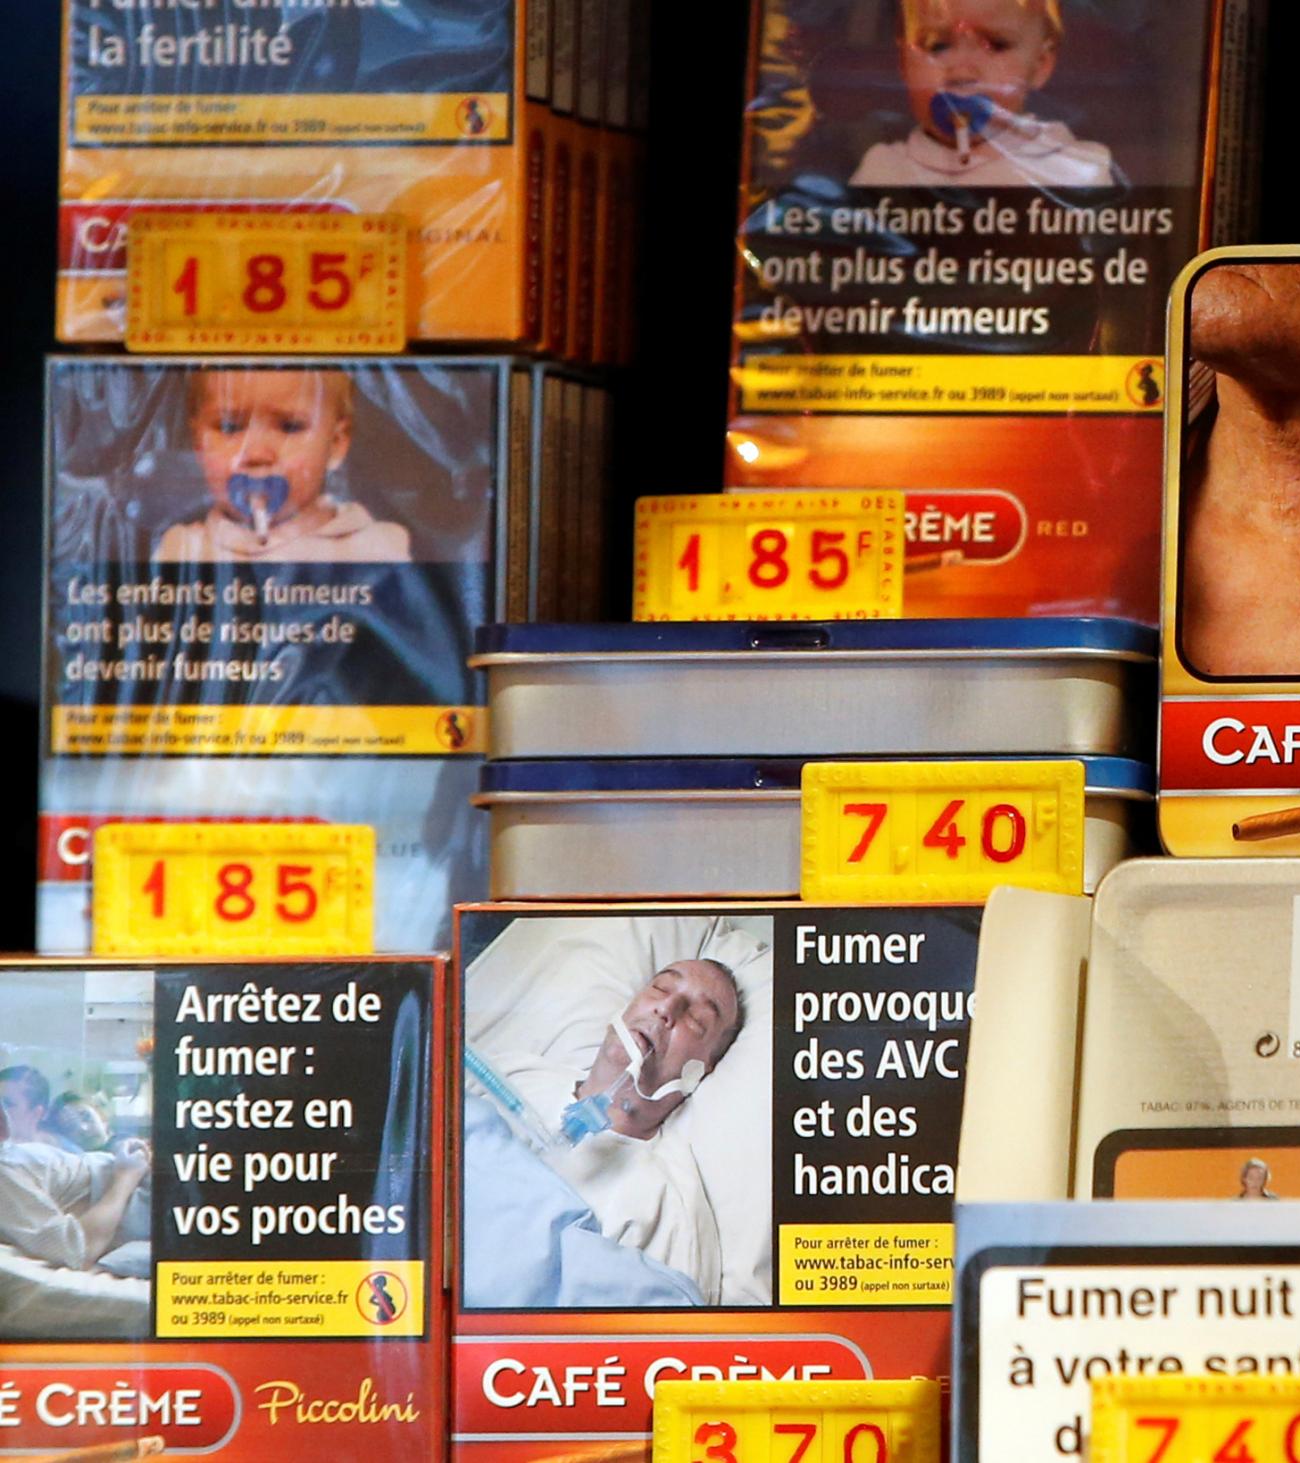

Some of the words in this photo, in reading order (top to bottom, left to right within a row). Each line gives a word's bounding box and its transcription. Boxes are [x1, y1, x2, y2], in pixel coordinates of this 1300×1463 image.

[89, 24, 124, 66] la
[139, 24, 292, 66] fertilité
[767, 200, 820, 235] Les
[832, 199, 963, 235] enfants
[974, 198, 1015, 235] de
[1027, 198, 1173, 235] fumeurs
[763, 256, 820, 284] ont
[831, 248, 903, 291] plus
[914, 248, 957, 284] de
[969, 249, 1094, 293] risques
[1104, 248, 1148, 284] de
[761, 299, 894, 335] devenir
[903, 298, 1050, 335] fumeurs
[905, 504, 995, 543] RÈME
[1037, 521, 1088, 537] RED
[68, 580, 108, 605] Les
[116, 578, 215, 605] enfants
[223, 577, 255, 605] de
[263, 577, 372, 605] fumeurs
[66, 621, 112, 642] ont
[118, 615, 173, 647] plus
[180, 615, 212, 642] de
[220, 615, 315, 647] risques
[320, 614, 355, 642] de
[66, 654, 165, 682] devenir
[173, 653, 285, 682] fumeurs
[796, 925, 925, 964] Fumer
[176, 984, 321, 1024] Arrêtez
[332, 982, 381, 1024] de
[175, 1036, 296, 1076] fumer
[793, 1038, 864, 1080] des
[876, 1039, 959, 1079] AVC
[176, 1092, 293, 1129] restez
[305, 1099, 352, 1128] en
[793, 1100, 835, 1137] et
[846, 1095, 917, 1137] des
[174, 1144, 232, 1183] vie
[244, 1150, 337, 1192] pour
[794, 1153, 955, 1195] handica
[174, 1206, 240, 1236] vos
[252, 1195, 405, 1244] proches
[794, 1237, 823, 1250] Pour
[827, 1235, 872, 1250] arrêter
[875, 1236, 890, 1250] de
[894, 1236, 930, 1250] fumer
[172, 1272, 202, 1285] Pour
[206, 1271, 255, 1285] arrêter
[258, 1271, 274, 1285] de
[278, 1271, 318, 1285] fumer
[794, 1279, 815, 1292] ou
[819, 1276, 858, 1292] 3989
[860, 1279, 889, 1294] (appel
[893, 1281, 909, 1291] non
[912, 1278, 950, 1293] surtaxé)
[1015, 1278, 1177, 1319] Fumer
[1197, 1276, 1293, 1318] nuit
[172, 1290, 348, 1306] www.tabac-info-service.fr
[172, 1313, 188, 1326] ou
[192, 1311, 225, 1326] 3989
[229, 1313, 260, 1328] (appel
[263, 1316, 282, 1326] non
[284, 1313, 324, 1327] surtaxé)
[482, 1355, 626, 1408] CAFÉ
[1009, 1345, 1036, 1387] à
[1055, 1350, 1183, 1386] votre
[36, 1381, 203, 1428] CRÈME
[254, 1377, 420, 1425] Piccolini
